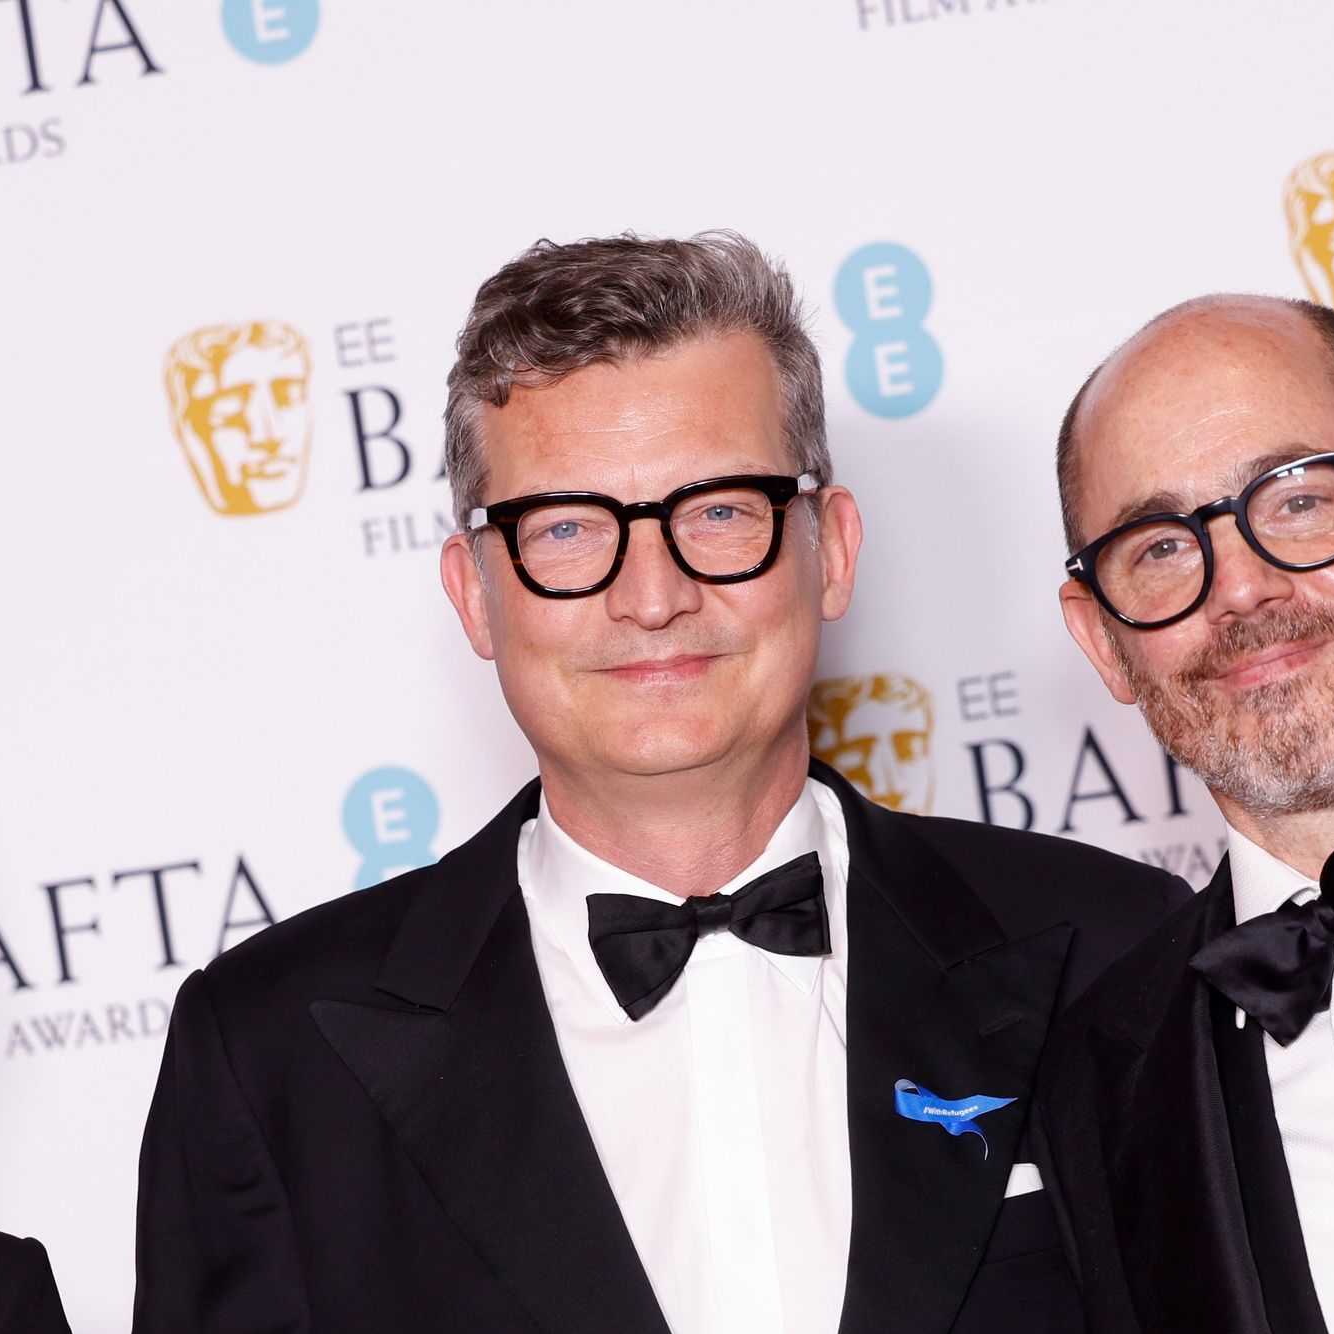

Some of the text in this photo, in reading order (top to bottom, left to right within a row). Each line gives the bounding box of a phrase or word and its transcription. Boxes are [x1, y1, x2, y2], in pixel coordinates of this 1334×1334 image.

[334, 317, 396, 369] EE
[957, 671, 1020, 722] EE
[5, 998, 170, 1060] AWARD
[922, 1103, 980, 1117] #WithRefugees
